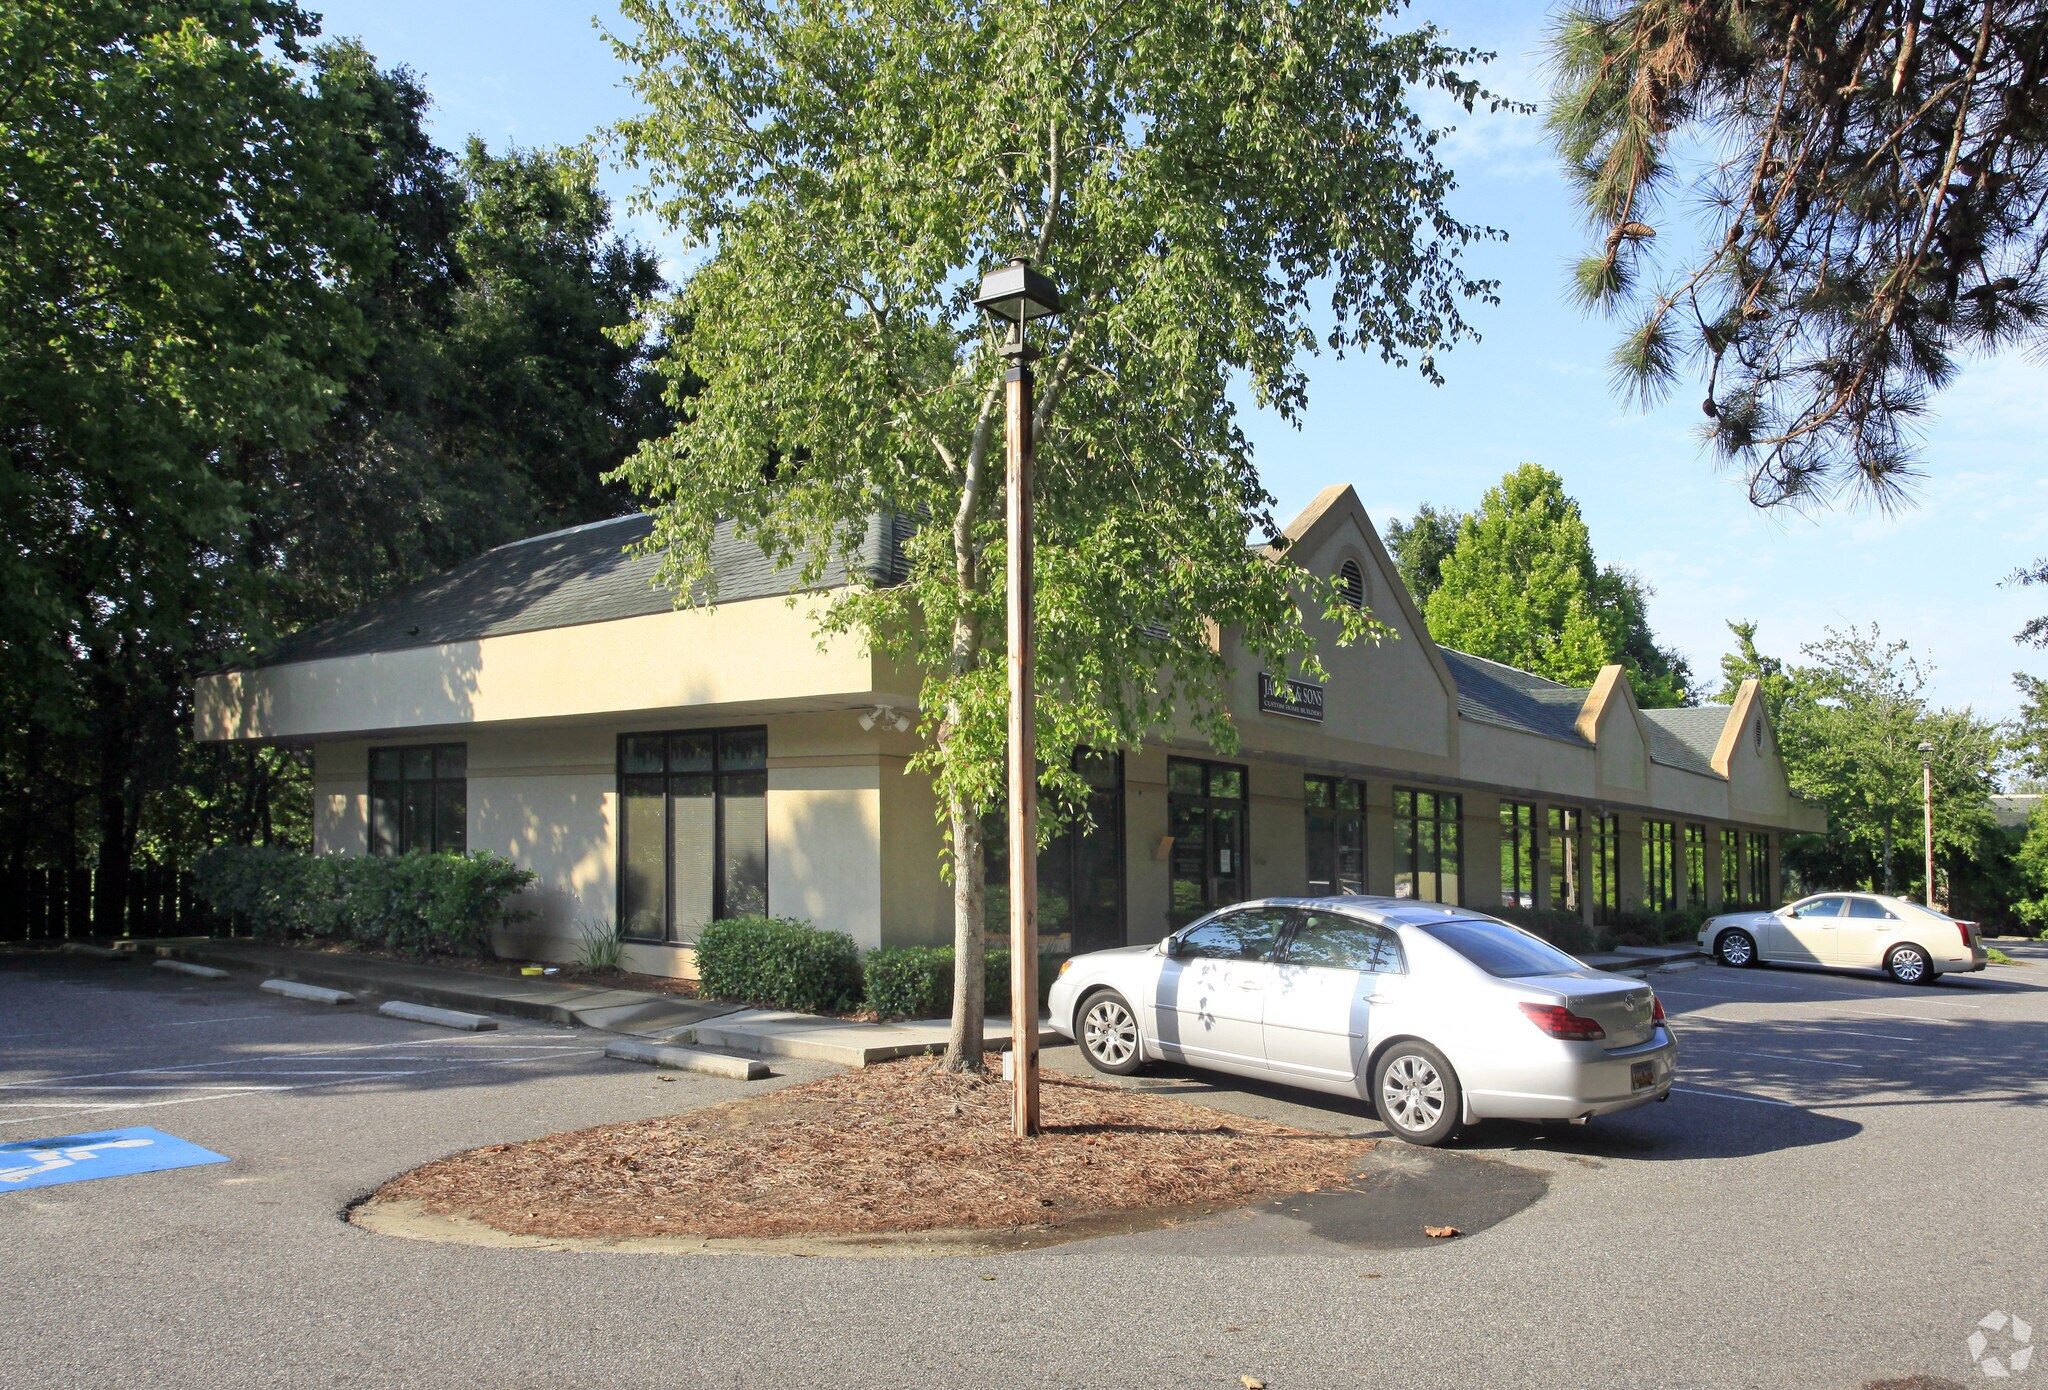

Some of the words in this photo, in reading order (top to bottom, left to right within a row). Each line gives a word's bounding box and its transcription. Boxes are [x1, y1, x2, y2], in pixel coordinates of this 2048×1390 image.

[1296, 686, 1302, 702] &
[1303, 688, 1322, 706] SONS
[1264, 700, 1285, 709] CUSTOM
